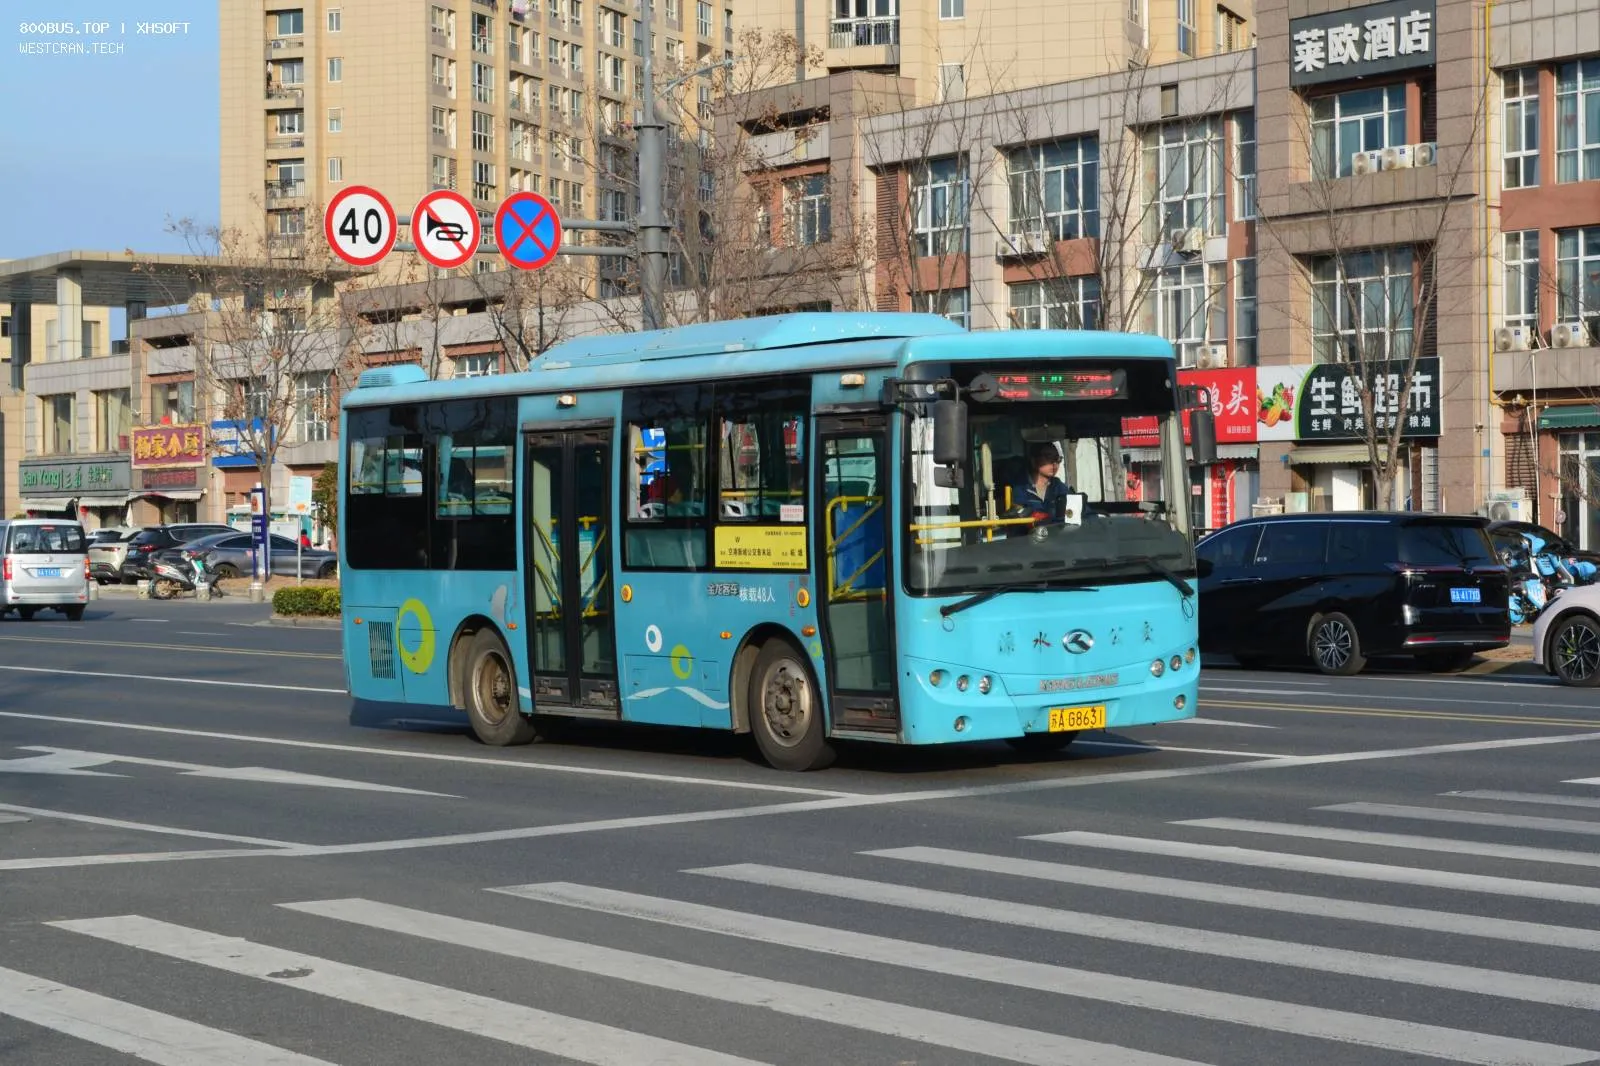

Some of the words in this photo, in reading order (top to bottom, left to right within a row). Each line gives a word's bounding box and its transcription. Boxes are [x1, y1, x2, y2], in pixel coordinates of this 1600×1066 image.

[1293, 9, 1432, 73] 莱欧酒店
[339, 207, 382, 245] 40
[1310, 371, 1432, 415] 生鲜超市
[1311, 418, 1332, 431] 生鲜
[1343, 417, 1365, 430] 肉类
[1409, 415, 1431, 428] 粮油
[40, 469, 60, 489] Yong
[739, 587, 776, 603] 核载48人
